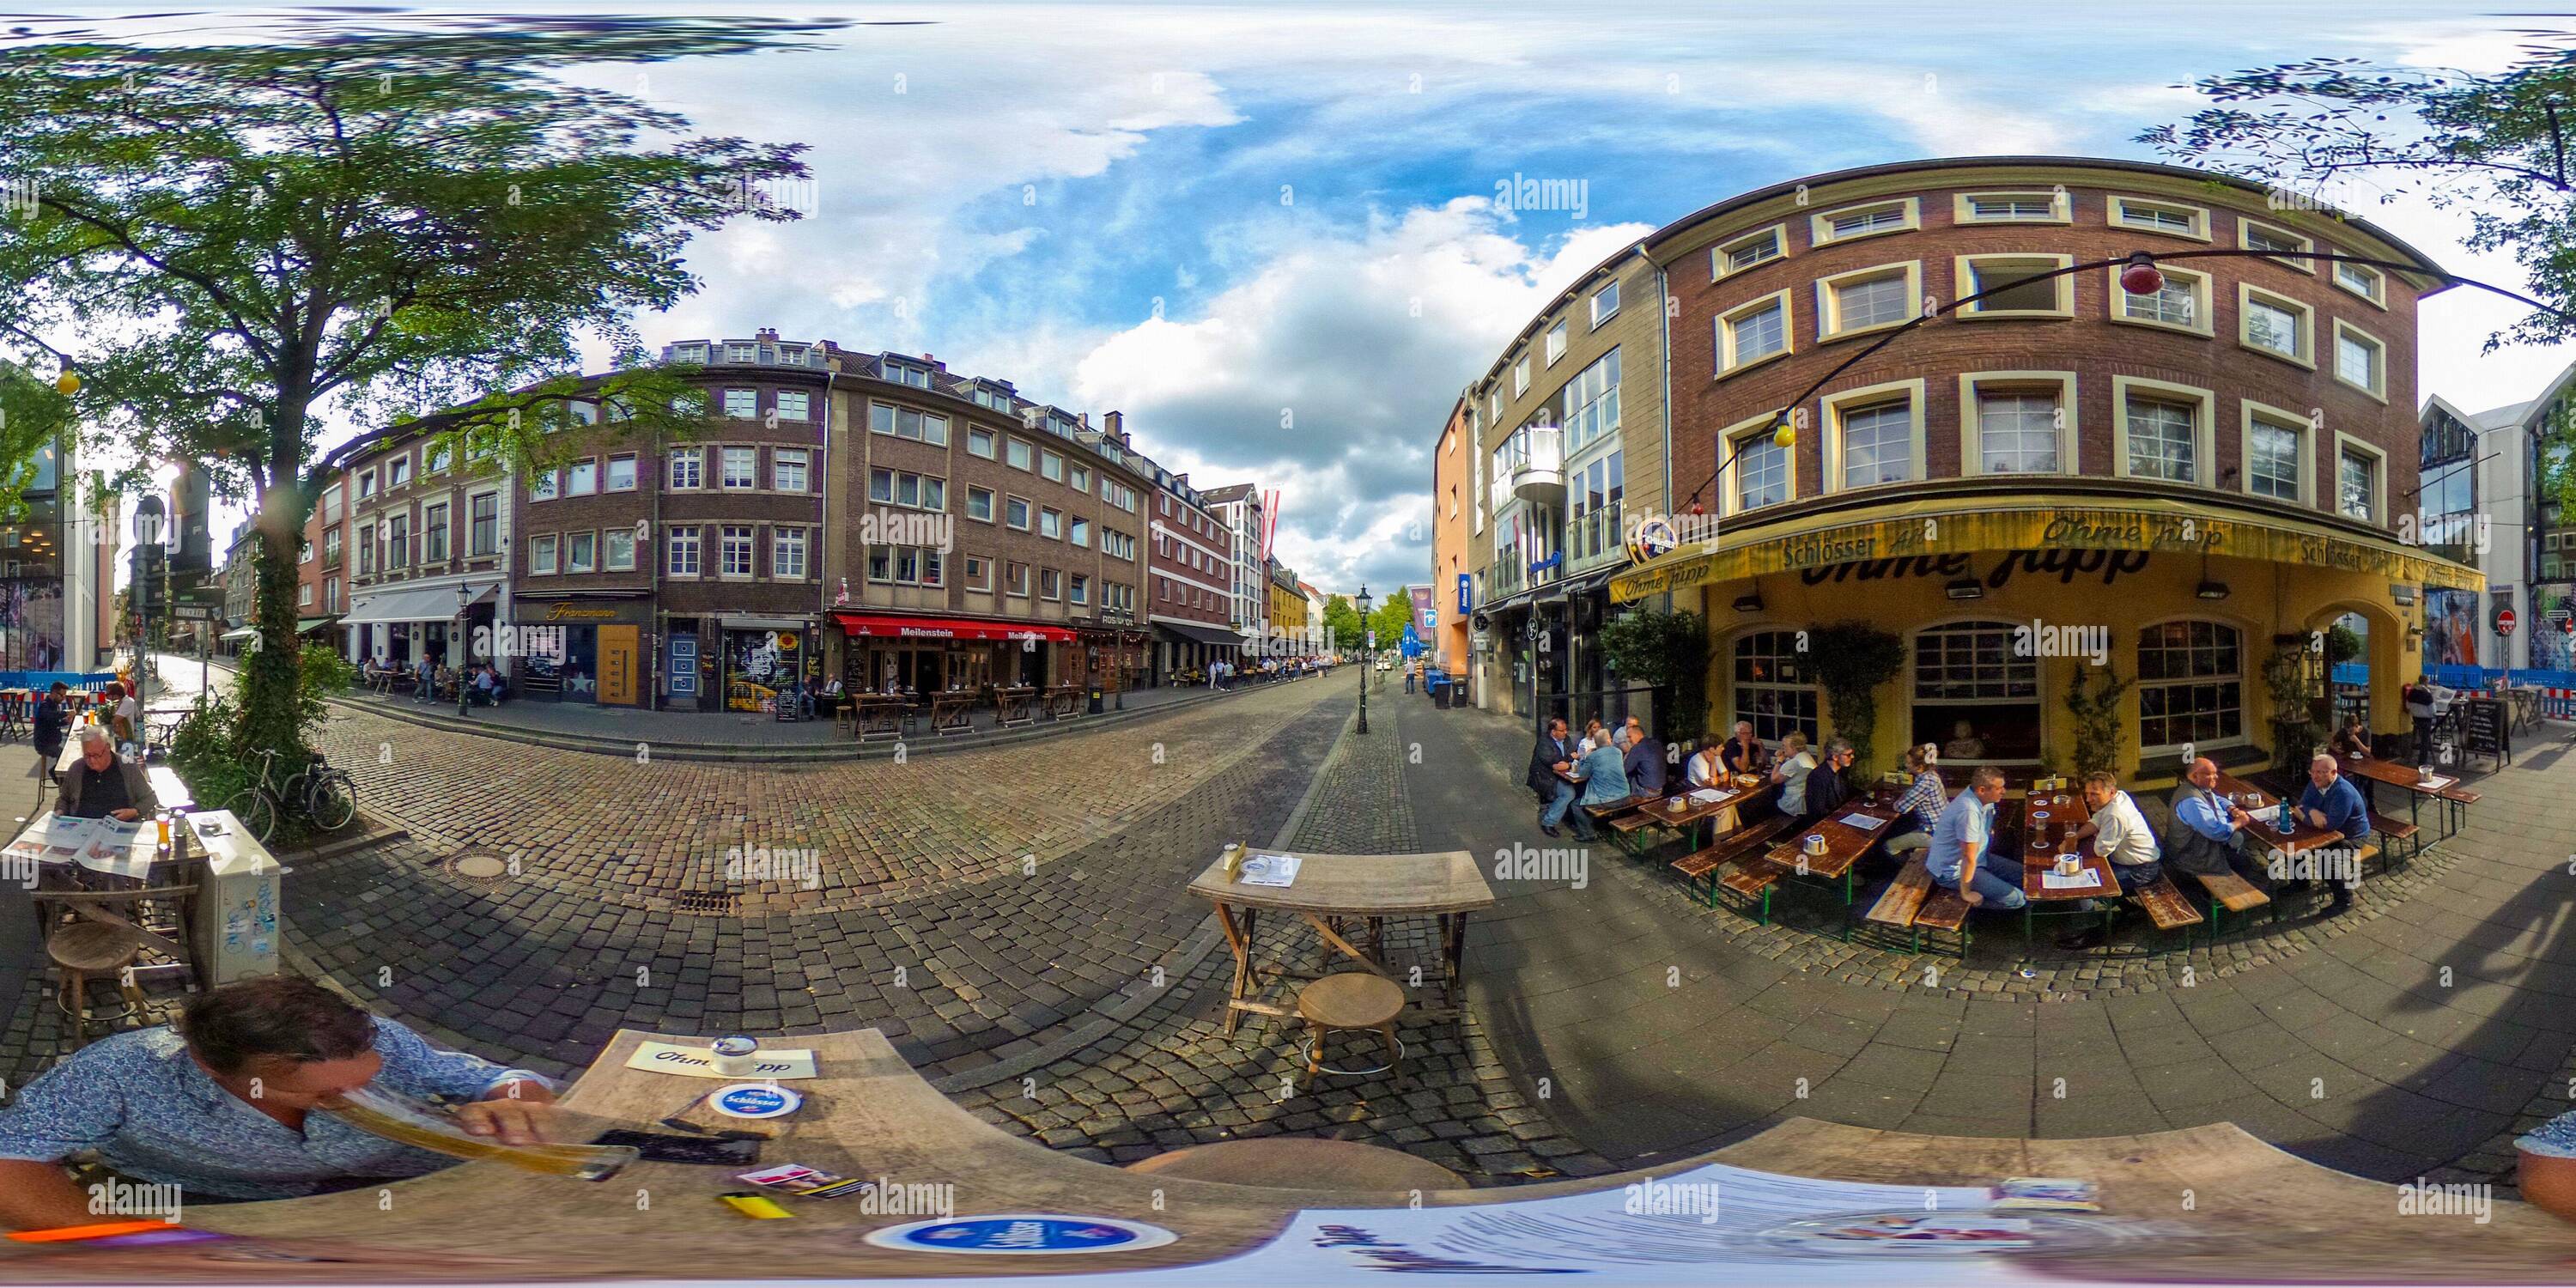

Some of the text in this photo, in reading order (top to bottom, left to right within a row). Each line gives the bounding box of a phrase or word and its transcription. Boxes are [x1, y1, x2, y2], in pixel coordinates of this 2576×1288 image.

[2043, 515, 2142, 544] Ohme
[1783, 538, 1875, 566] Schlösser
[2300, 538, 2361, 570] Schlösser
[1625, 577, 1663, 596] Ohme
[546, 601, 617, 621] Franzmann
[901, 628, 953, 637] Meilenstein
[654, 1050, 711, 1066] Ohm
[726, 1095, 781, 1107] Schlösser
